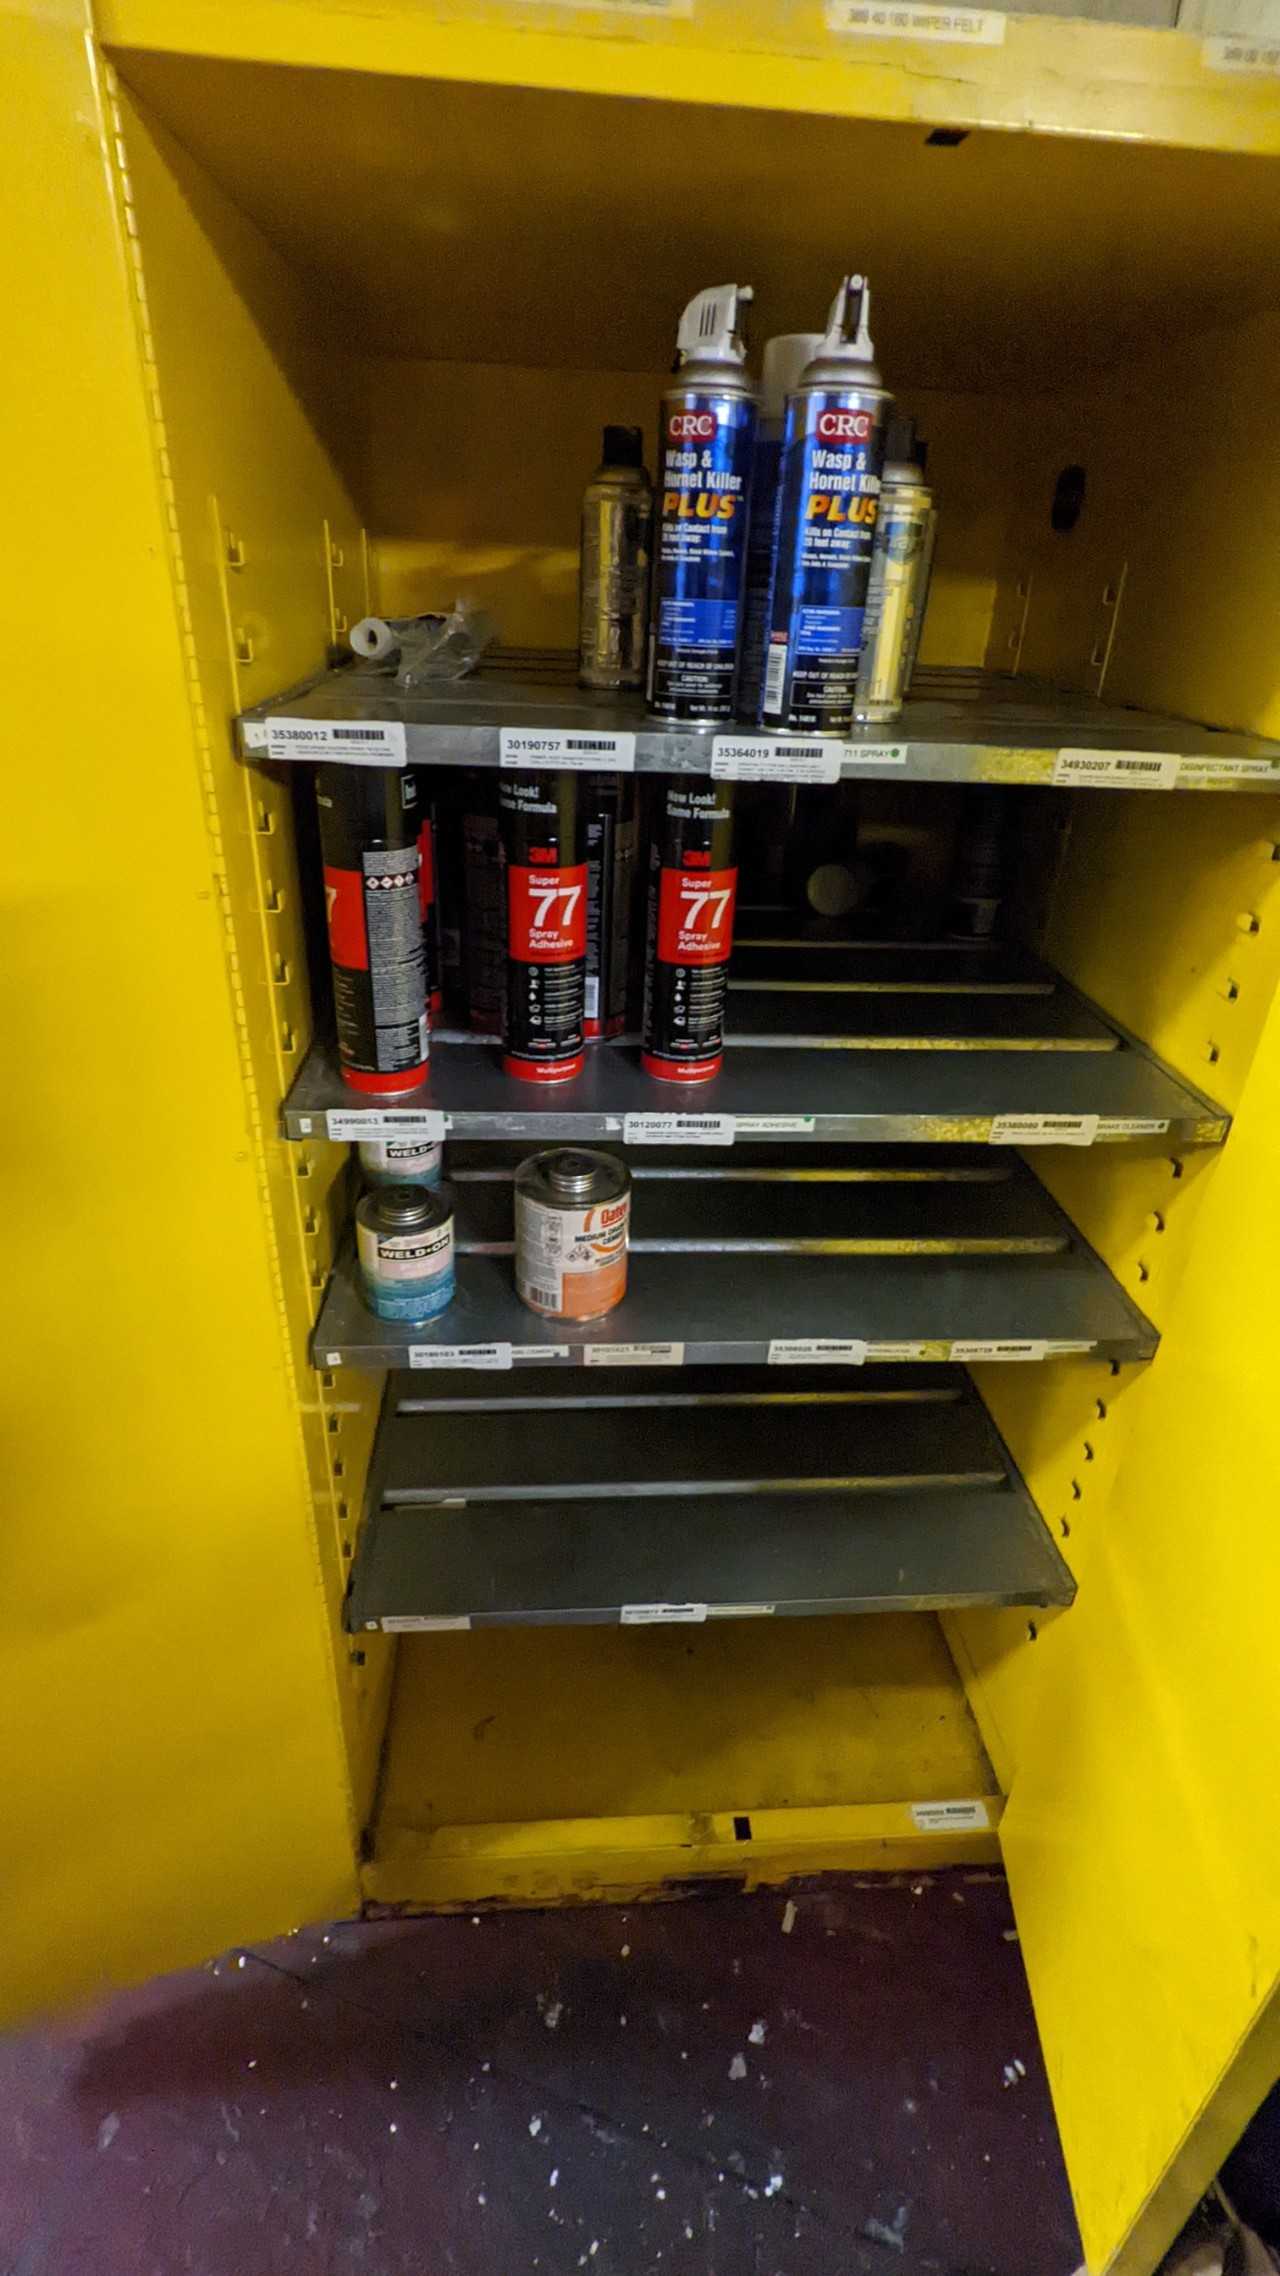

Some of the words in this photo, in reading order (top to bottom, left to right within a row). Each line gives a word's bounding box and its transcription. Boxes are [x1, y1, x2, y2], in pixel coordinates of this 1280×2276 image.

[669, 415, 713, 436] CRC
[819, 413, 869, 437] CRC
[665, 450, 697, 468] Wasp
[701, 449, 712, 468] &
[811, 450, 851, 471] Wasp
[855, 452, 866, 470] &
[664, 471, 702, 488] Hornet
[706, 471, 742, 490] Killer
[809, 472, 856, 491] Hornet
[662, 492, 736, 519] PLUS
[805, 494, 877, 525] PLUS
[271, 730, 328, 741] 35380012
[507, 739, 560, 751] 30190757
[717, 747, 769, 758] 35364019
[517, 801, 557, 814] Formula
[693, 806, 730, 819] Formula
[529, 847, 558, 864] 3M
[528, 874, 560, 885] Super
[682, 877, 712, 888] Super
[528, 885, 582, 927] 77
[680, 888, 732, 929] 77
[528, 927, 559, 940] Spray
[677, 930, 708, 942] Spray
[528, 938, 574, 949] Adhesive
[677, 940, 721, 951] Adhesive
